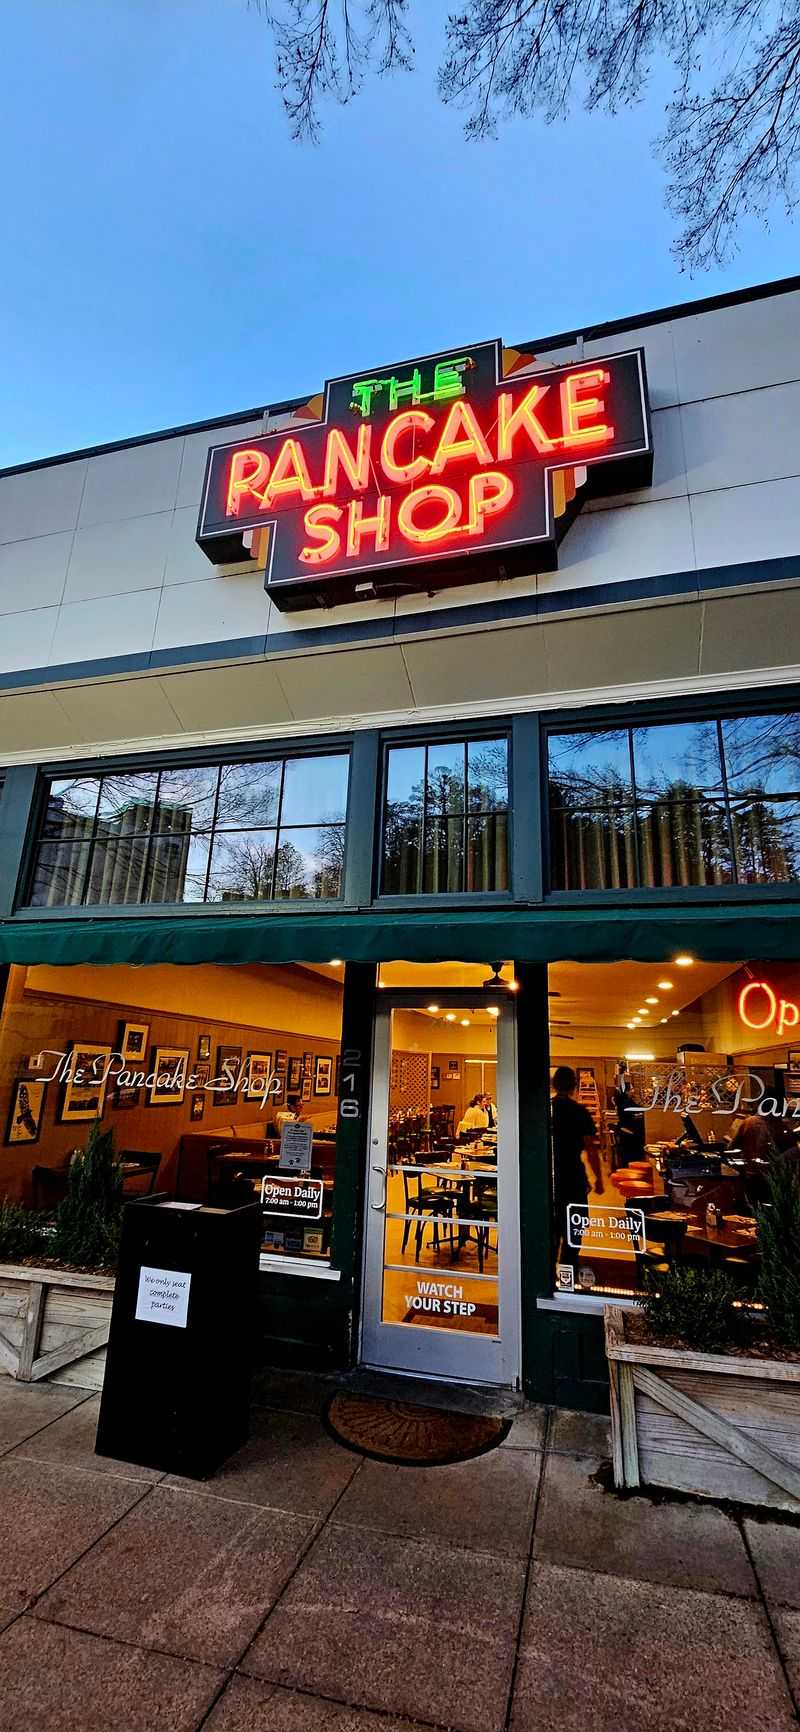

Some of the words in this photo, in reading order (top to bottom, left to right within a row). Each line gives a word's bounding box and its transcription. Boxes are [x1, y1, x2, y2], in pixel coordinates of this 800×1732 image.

[352, 356, 474, 416] THE
[226, 369, 615, 516] PANCAKE
[298, 471, 514, 564] SHOP
[36, 1050, 84, 1084] The
[89, 1053, 200, 1090] Pancake
[204, 1056, 283, 1110] Shop
[340, 1049, 361, 1118] 216
[624, 1070, 702, 1114] The
[265, 1184, 291, 1197] Open
[294, 1186, 320, 1201] Daily
[265, 1197, 279, 1205] 7:00
[279, 1198, 290, 1206] am
[294, 1199, 307, 1207] 1:00
[307, 1201, 318, 1209] pm
[571, 1213, 604, 1228] Open
[608, 1216, 641, 1232] Daily
[610, 1232, 625, 1240] 1:00
[627, 1233, 641, 1242] pm
[150, 1290, 179, 1299] complete
[416, 1281, 463, 1298] WATCH
[151, 1301, 175, 1311] parties
[404, 1295, 441, 1313] YOUR
[443, 1300, 476, 1316] STEP
